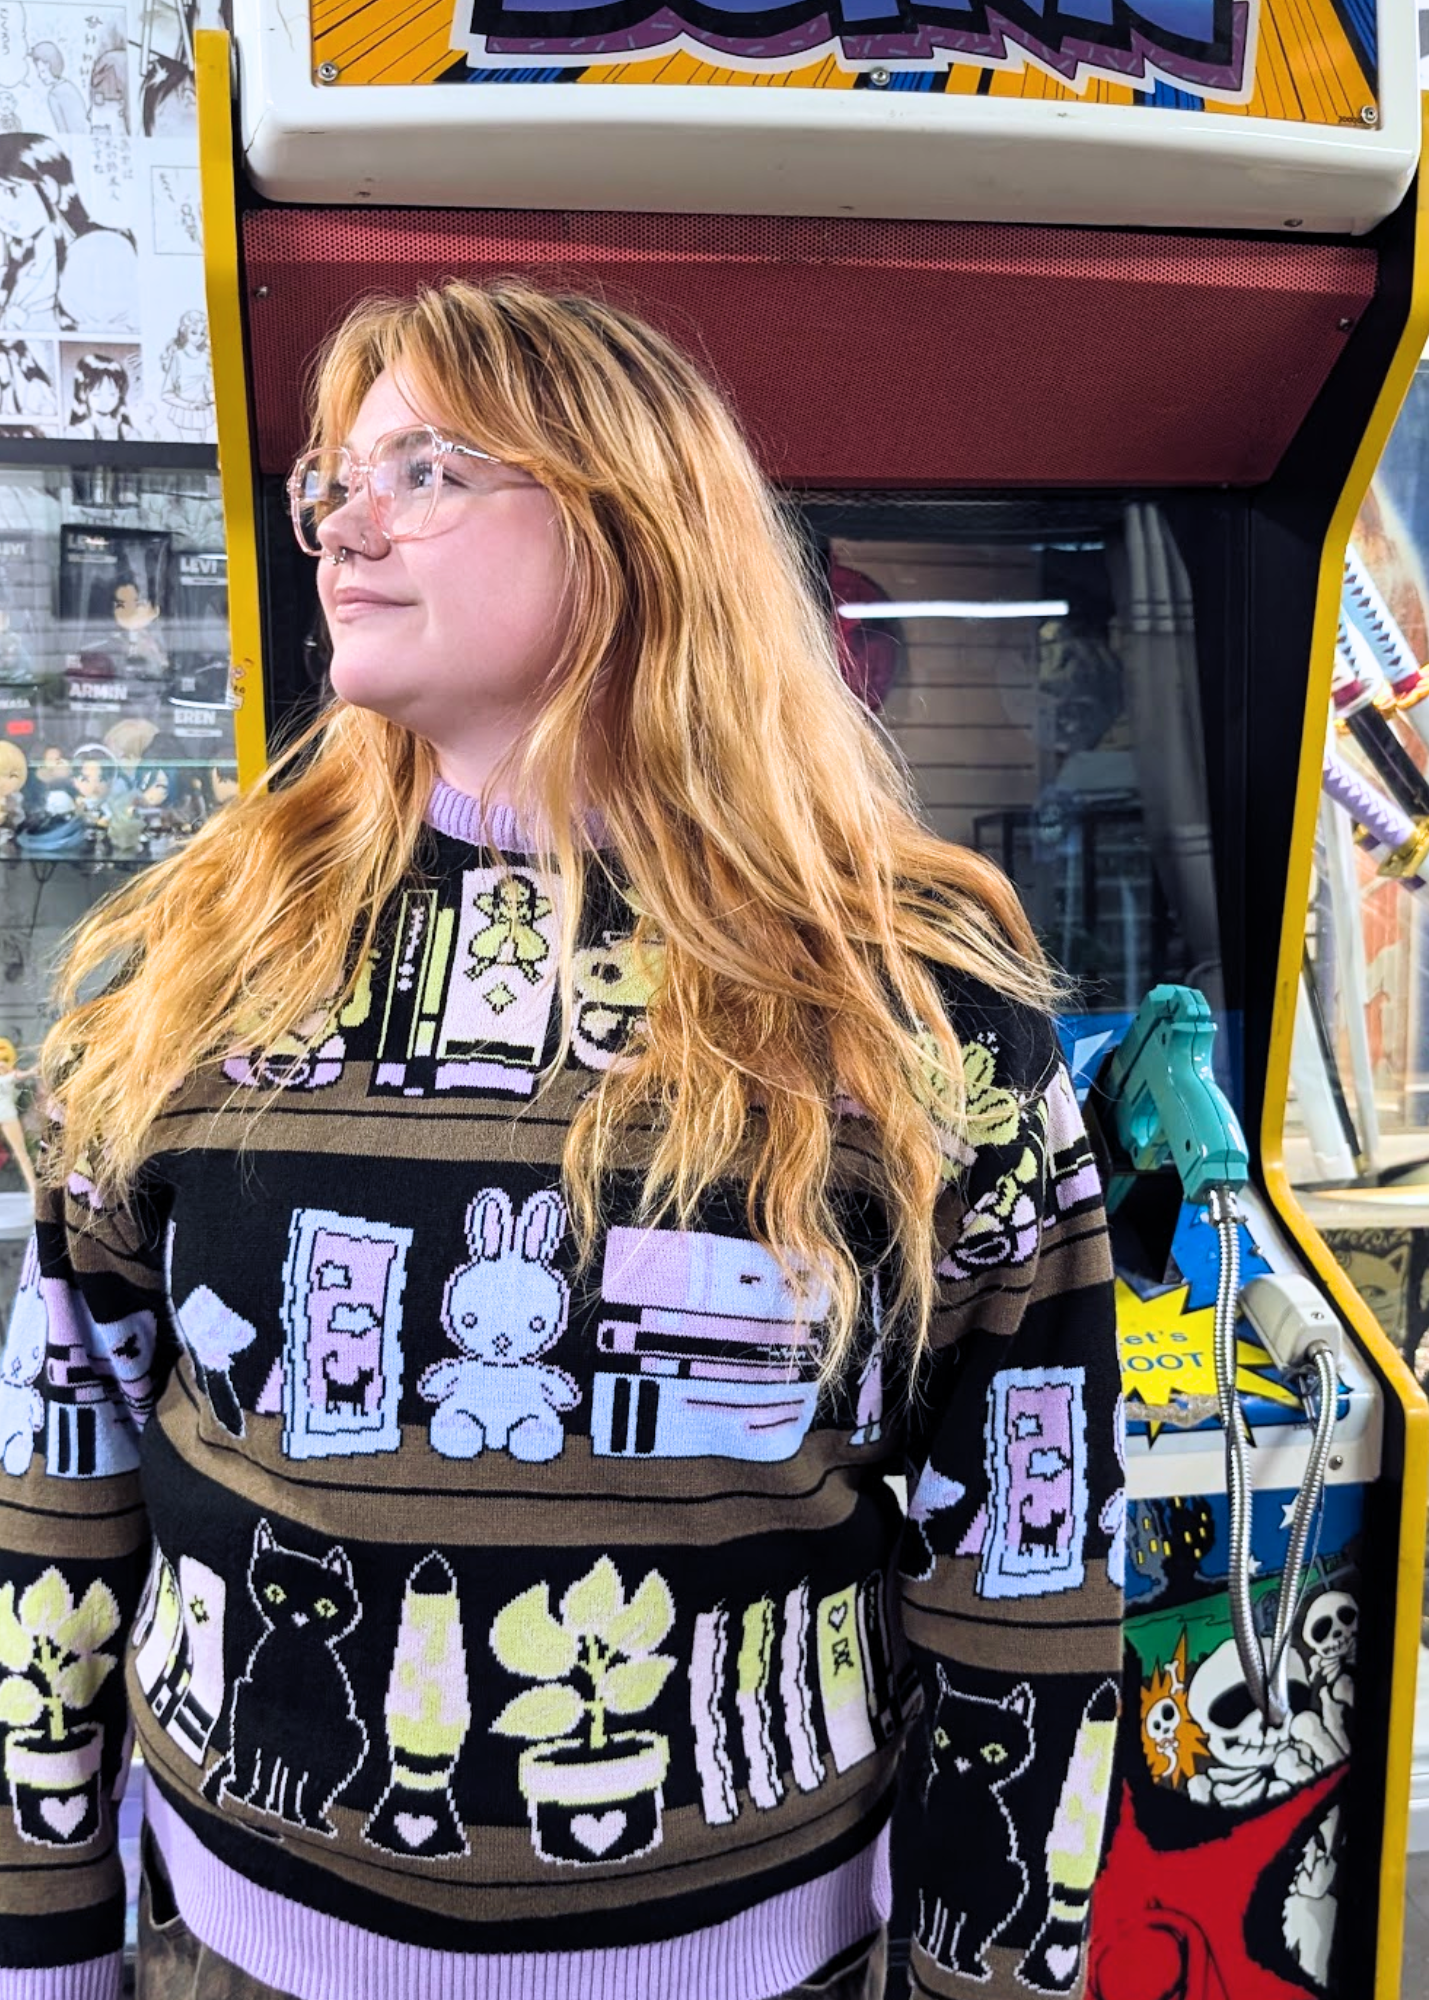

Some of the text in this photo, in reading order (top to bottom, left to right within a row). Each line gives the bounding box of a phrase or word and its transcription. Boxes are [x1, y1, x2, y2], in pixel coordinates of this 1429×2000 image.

[180, 556, 218, 575] LEVI
[68, 681, 128, 700] ARMIN
[174, 709, 217, 725] EREN
[1119, 1331, 1188, 1345] et's
[1121, 1352, 1204, 1372] OOT
